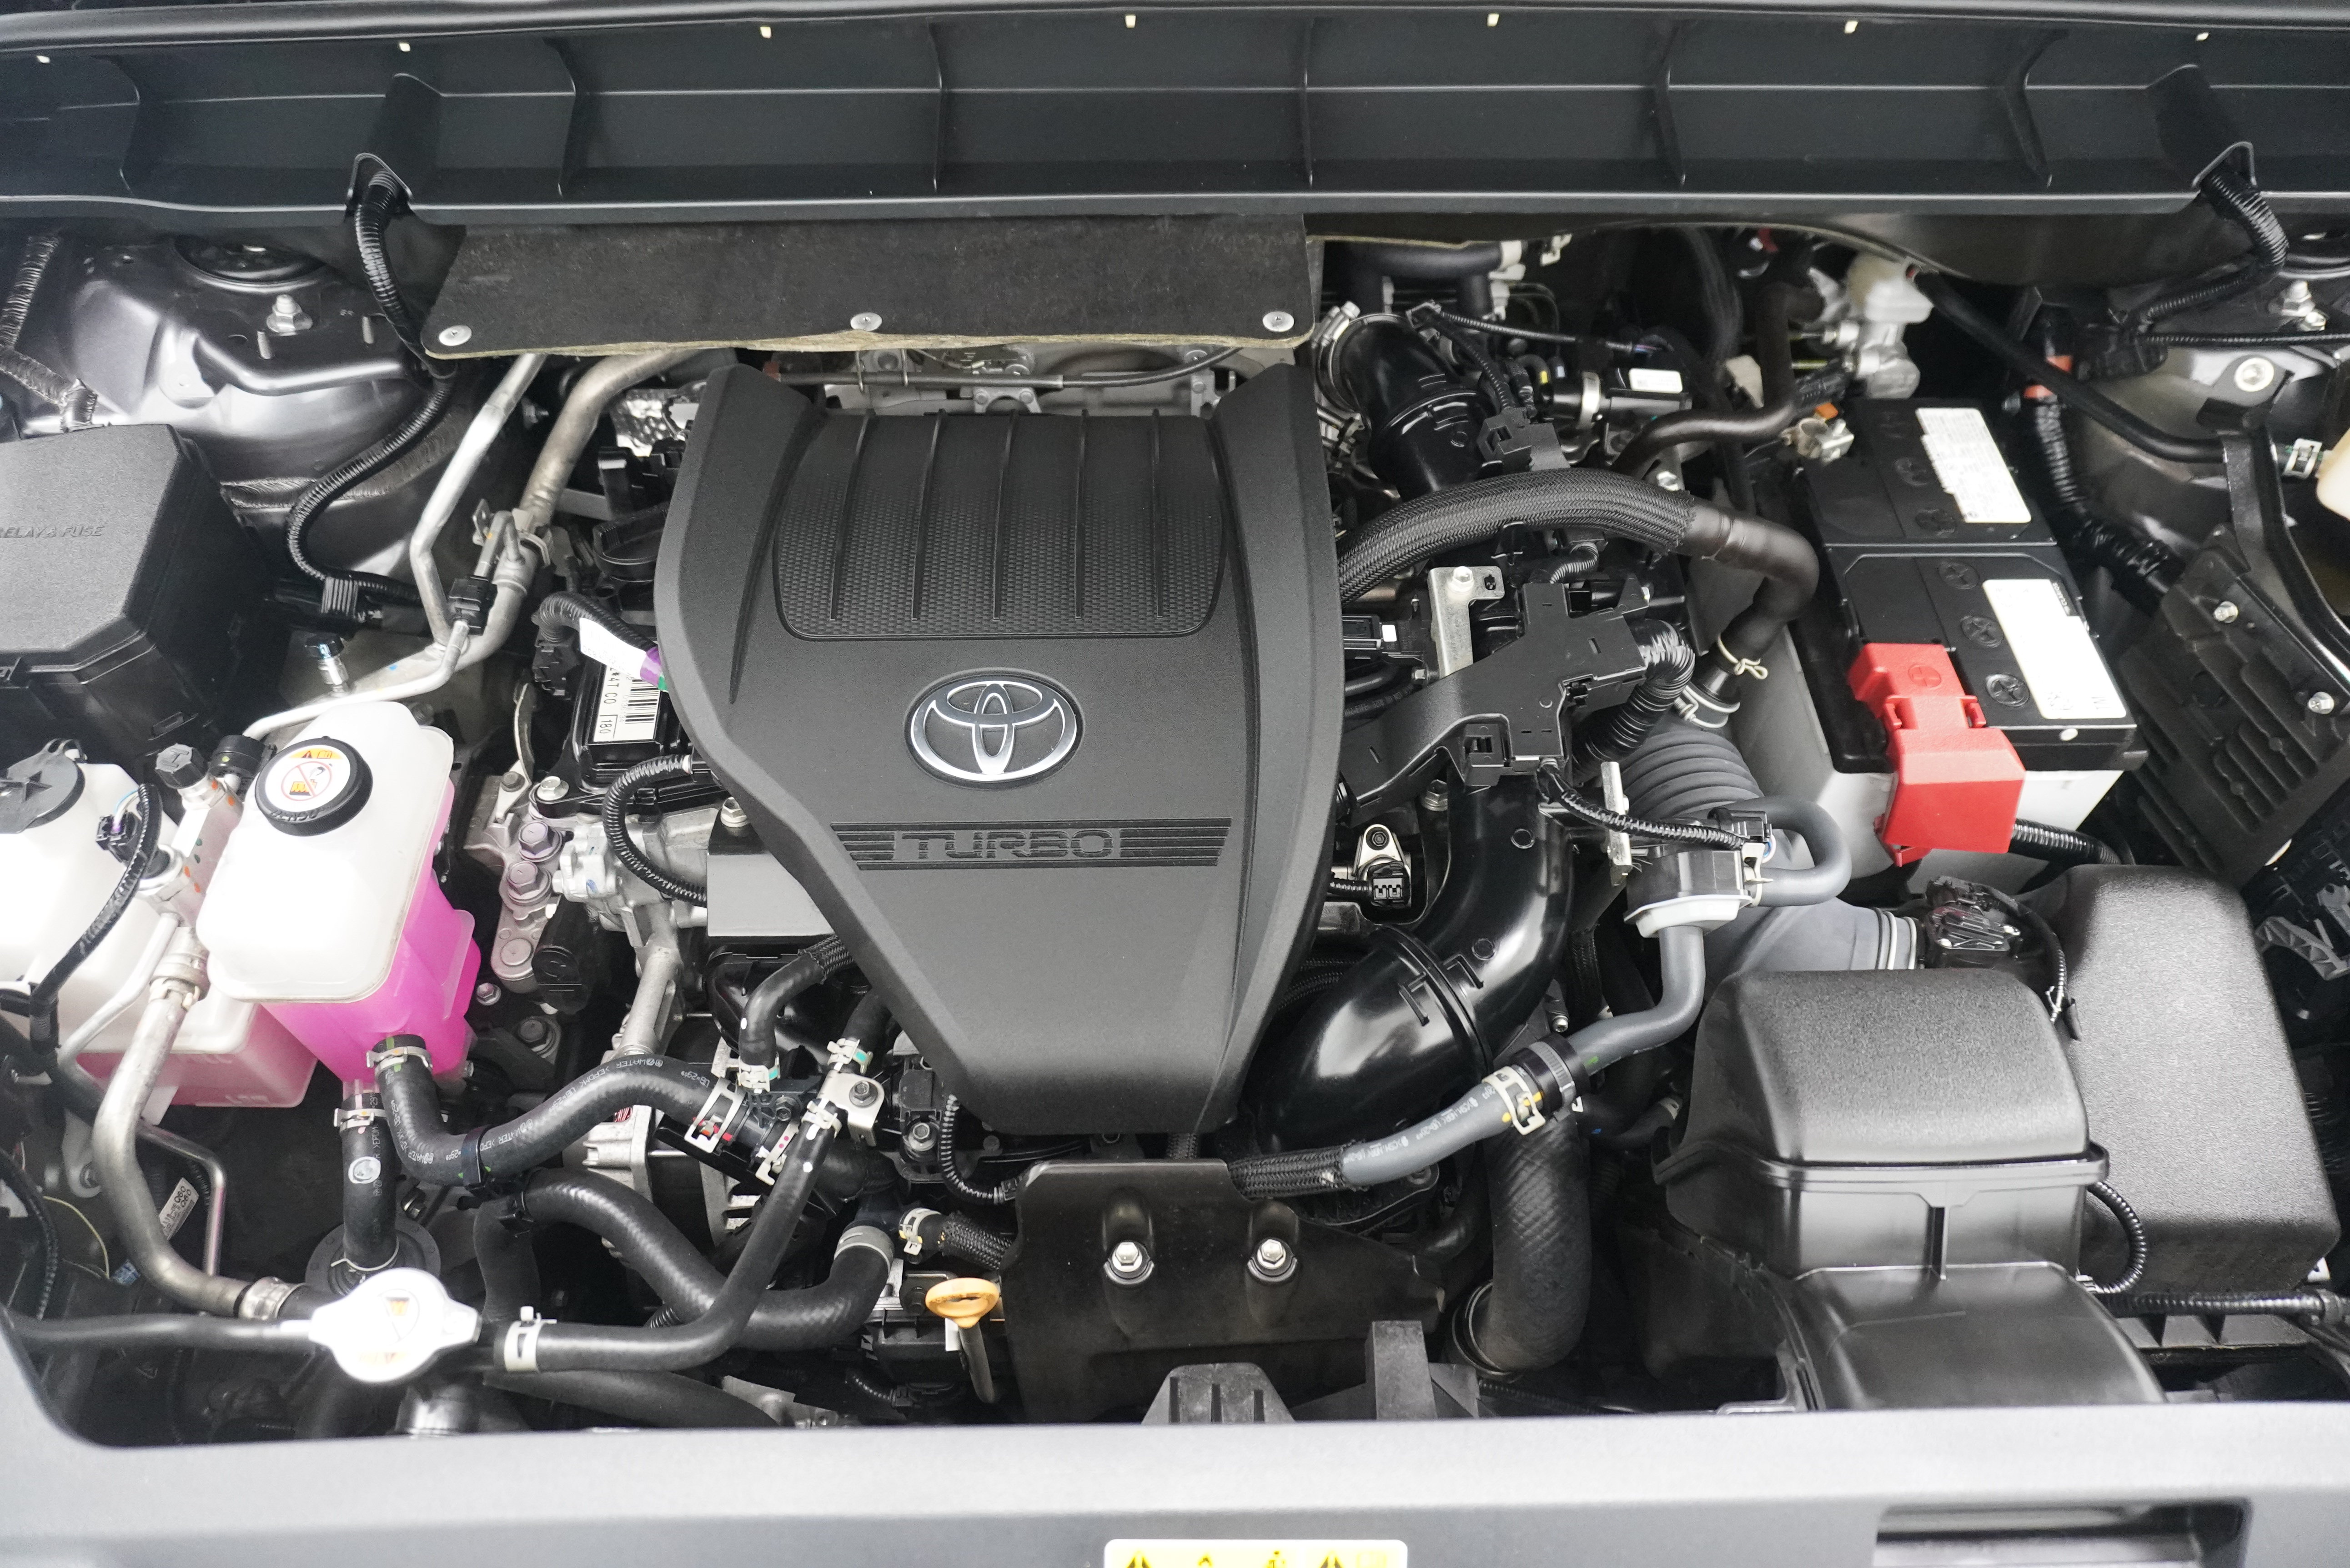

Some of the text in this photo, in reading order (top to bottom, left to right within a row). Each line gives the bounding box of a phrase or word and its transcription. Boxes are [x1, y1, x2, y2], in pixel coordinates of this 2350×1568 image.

[61, 526, 105, 538] FUSE
[2052, 582, 2067, 606] CLARIOS
[599, 720, 613, 734] 180
[901, 829, 1114, 859] TURBO
[616, 1059, 647, 1069] WATER
